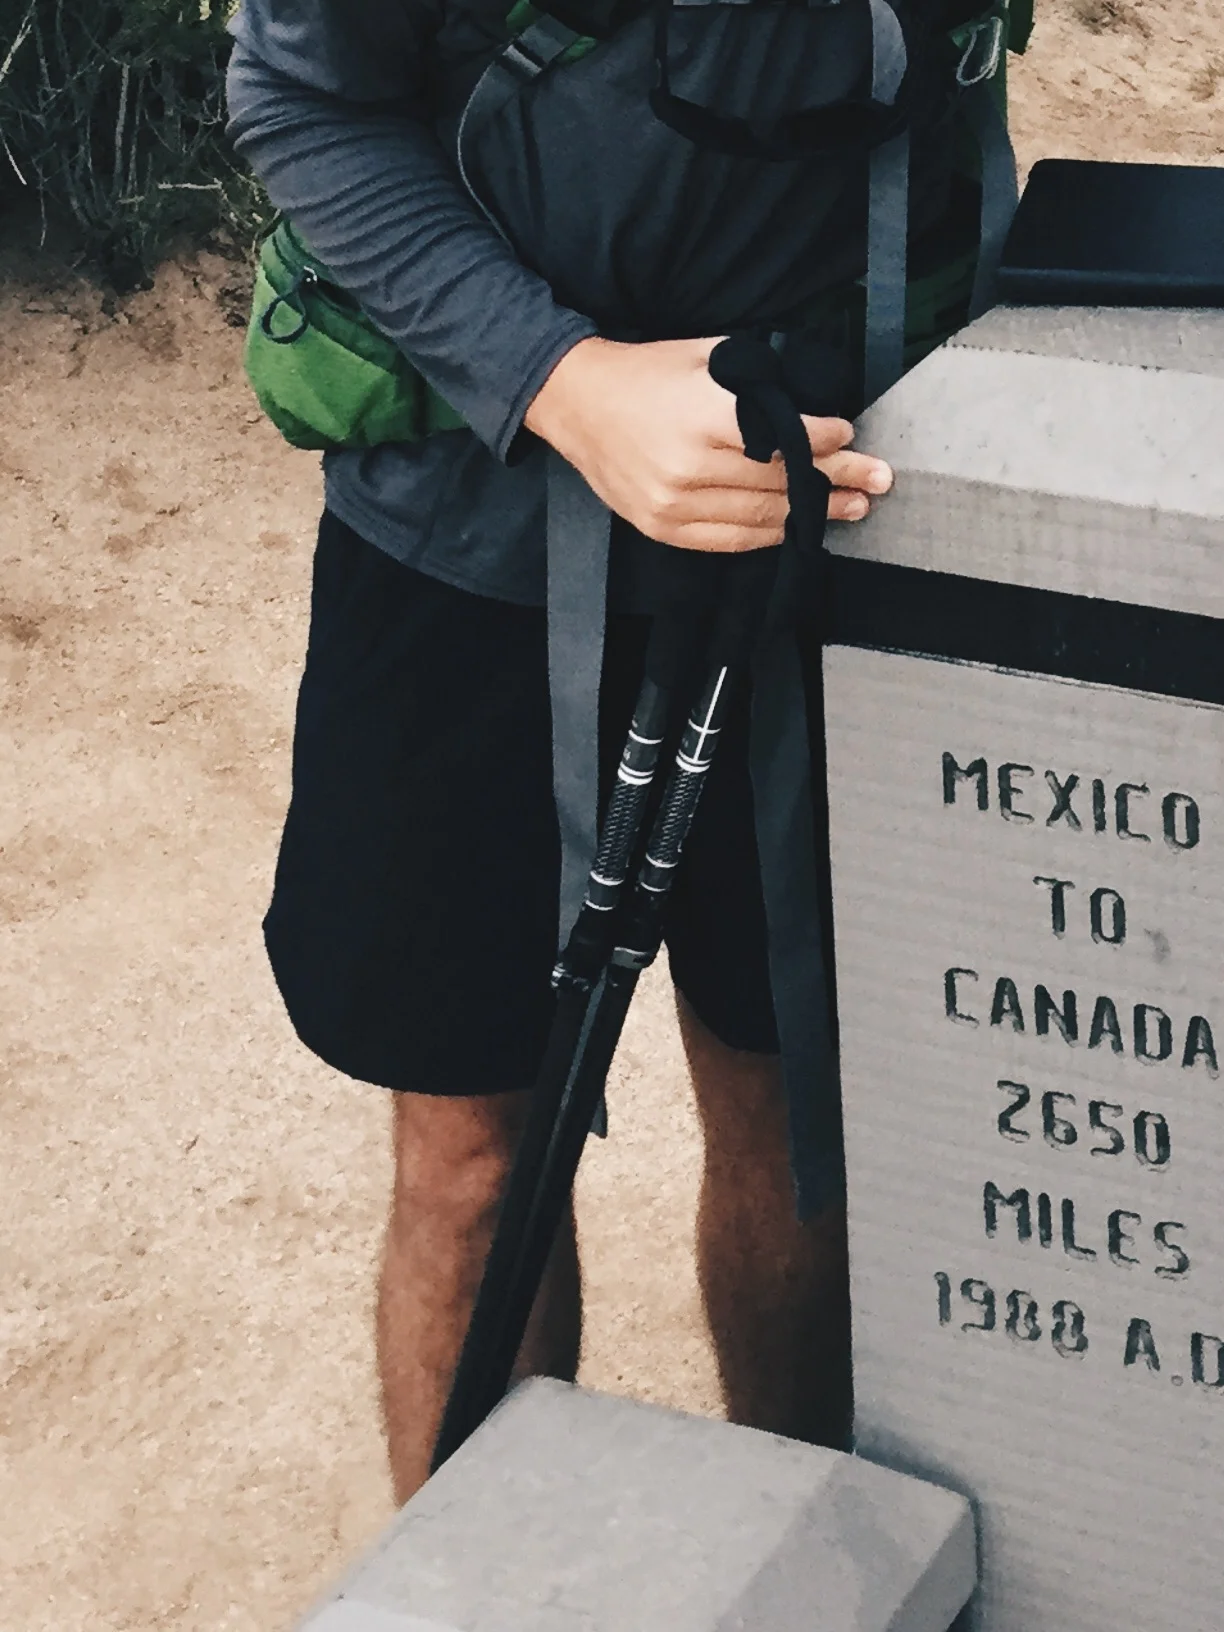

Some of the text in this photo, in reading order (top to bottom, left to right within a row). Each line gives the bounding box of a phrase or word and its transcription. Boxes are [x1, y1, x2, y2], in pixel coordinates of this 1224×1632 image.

[941, 751, 1201, 851] MEXICO
[1032, 875, 1127, 946] TO
[943, 967, 1220, 1075] CANADA
[996, 1079, 1172, 1171] 2650
[983, 1180, 1191, 1278] MILES
[934, 1271, 1090, 1358] 1988
